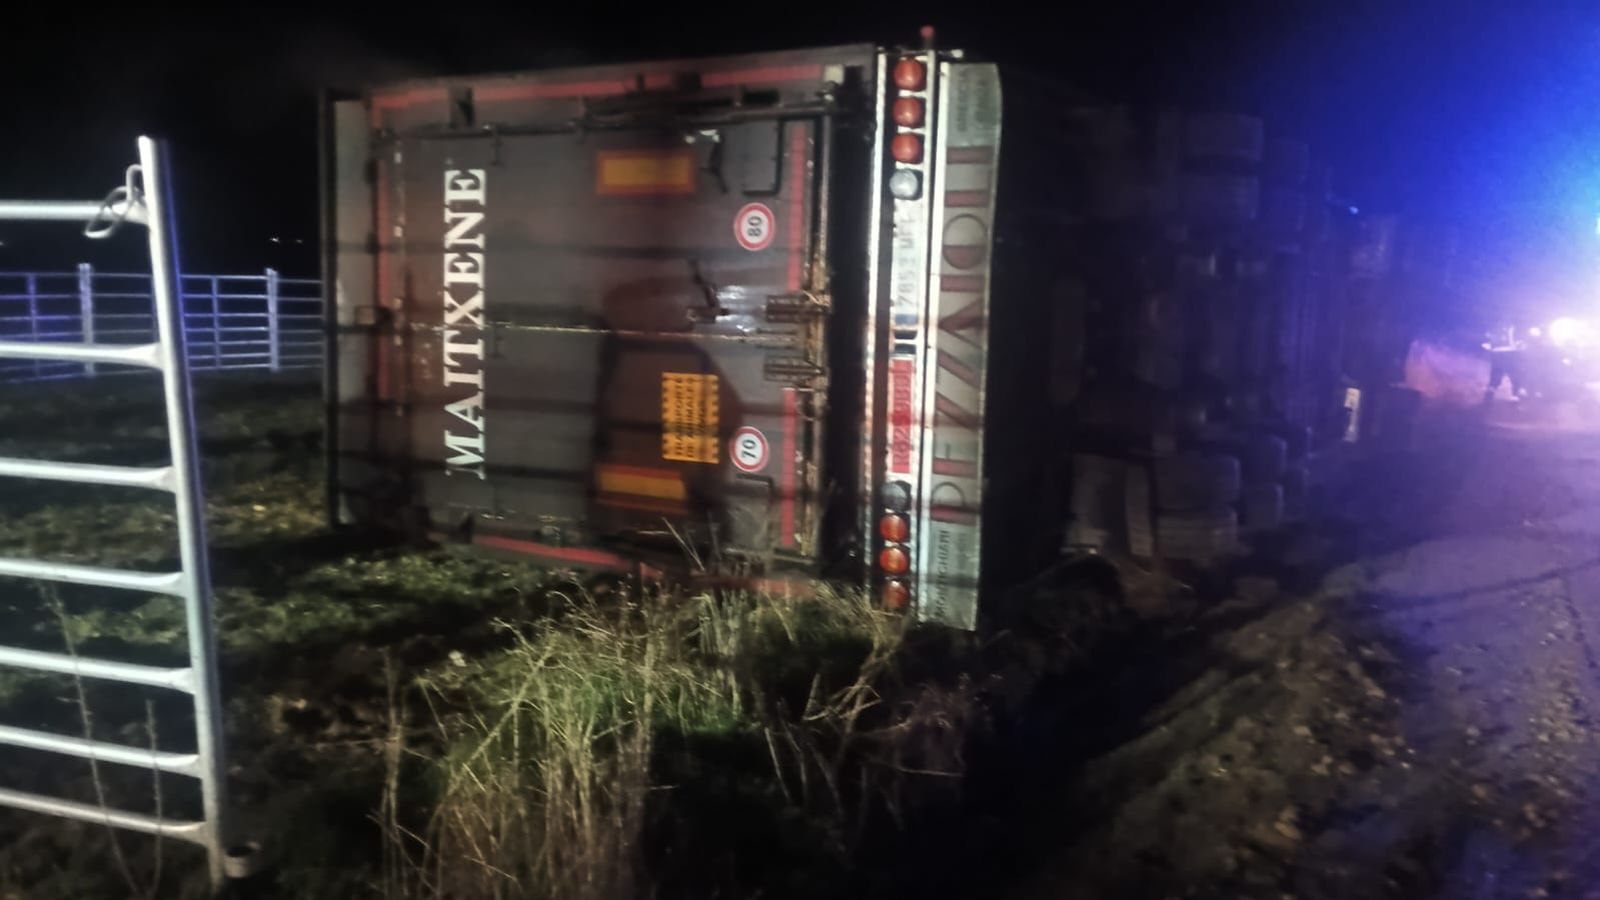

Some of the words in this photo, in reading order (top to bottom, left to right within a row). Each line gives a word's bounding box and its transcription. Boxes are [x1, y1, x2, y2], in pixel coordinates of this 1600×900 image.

[747, 215, 762, 237] 80
[444, 168, 486, 481] MAITXENE
[741, 439, 757, 459] 70
